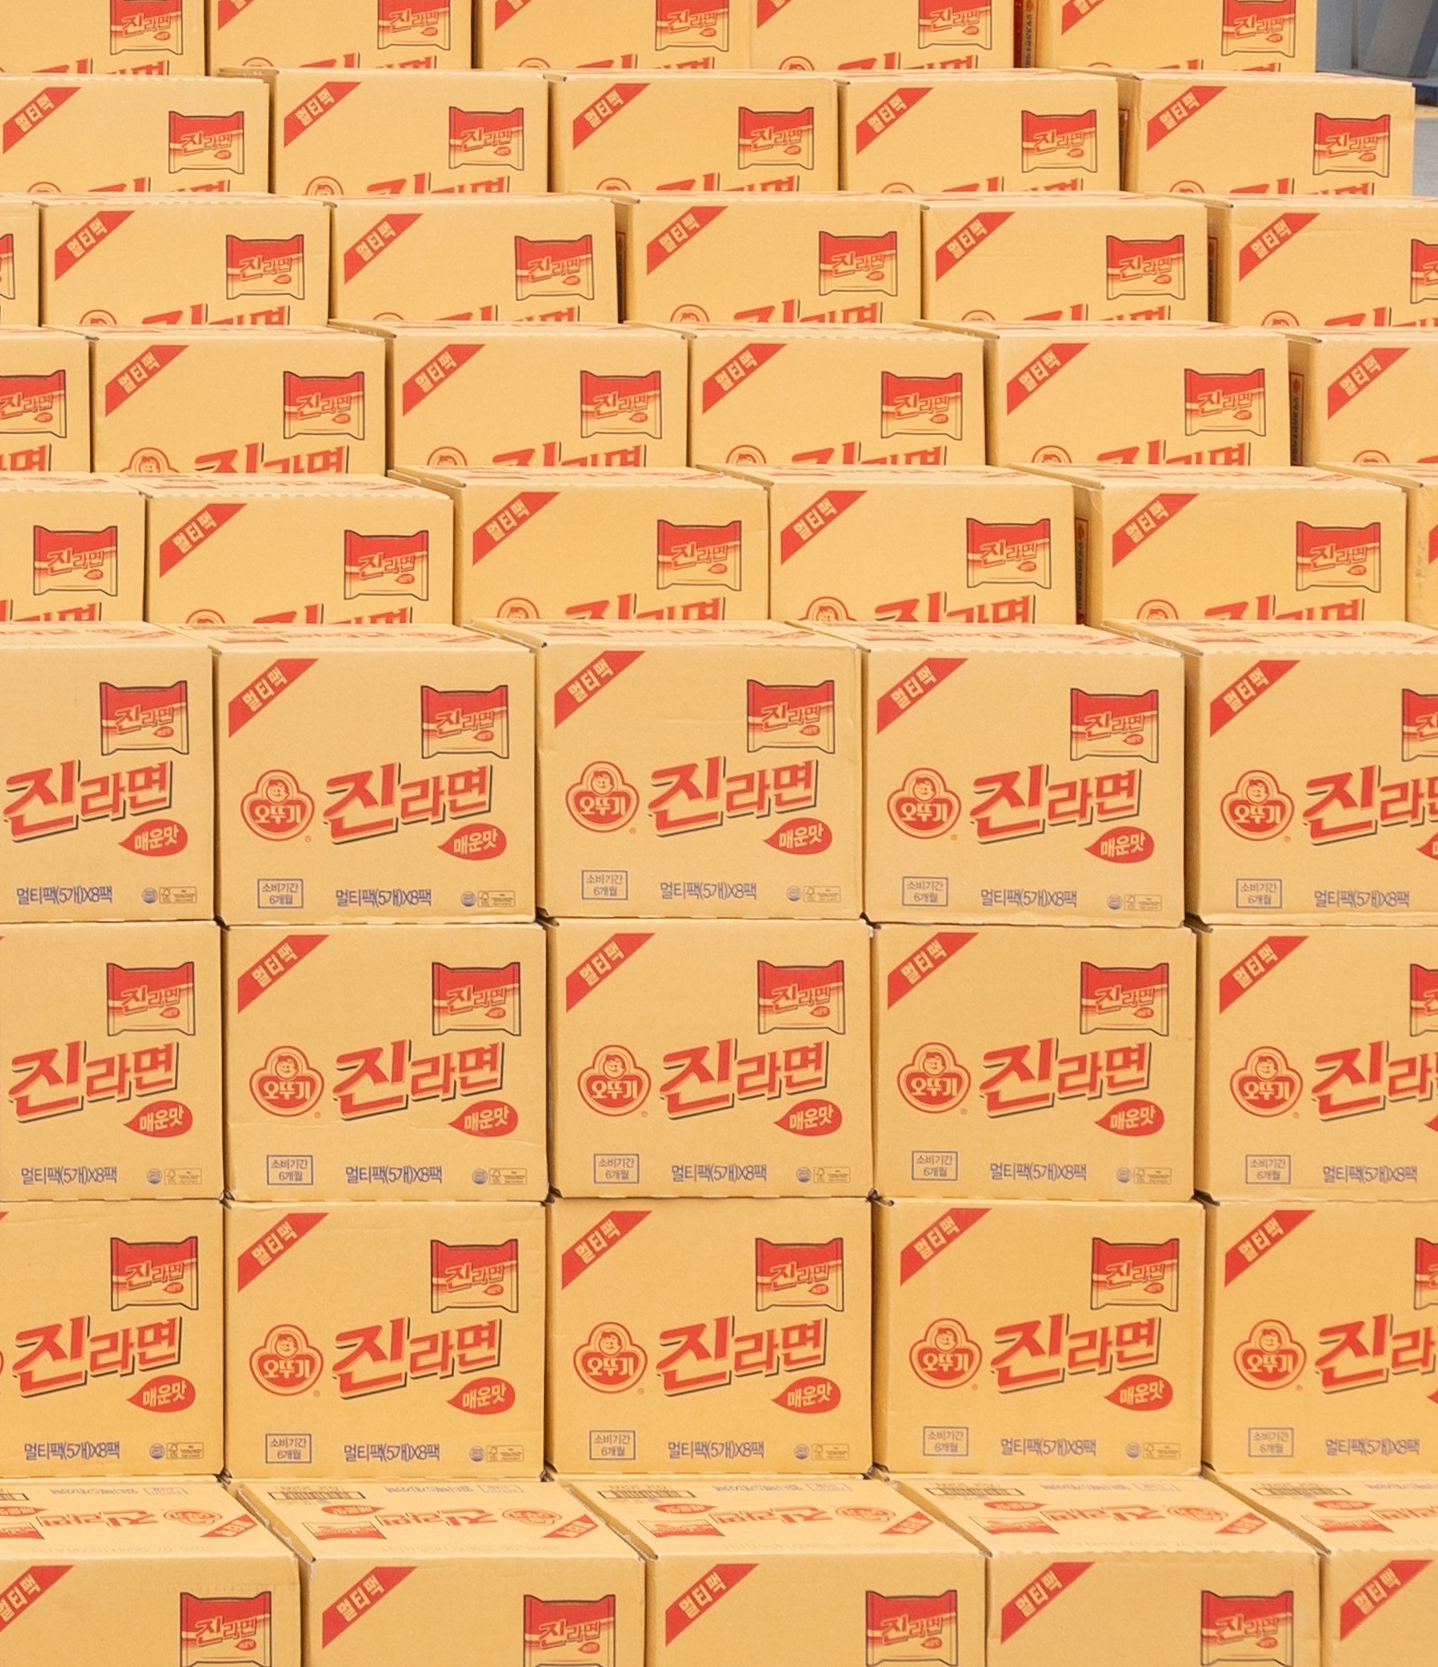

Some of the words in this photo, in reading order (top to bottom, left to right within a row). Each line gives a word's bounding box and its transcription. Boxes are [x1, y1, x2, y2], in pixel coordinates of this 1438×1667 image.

[323, 763, 491, 845] 진라면
[779, 823, 823, 849] 매운맛
[970, 765, 1139, 846] 진라면
[660, 1039, 827, 1121] 진라면
[911, 1078, 958, 1097] 오뚜기
[332, 1318, 500, 1400] 진라면
